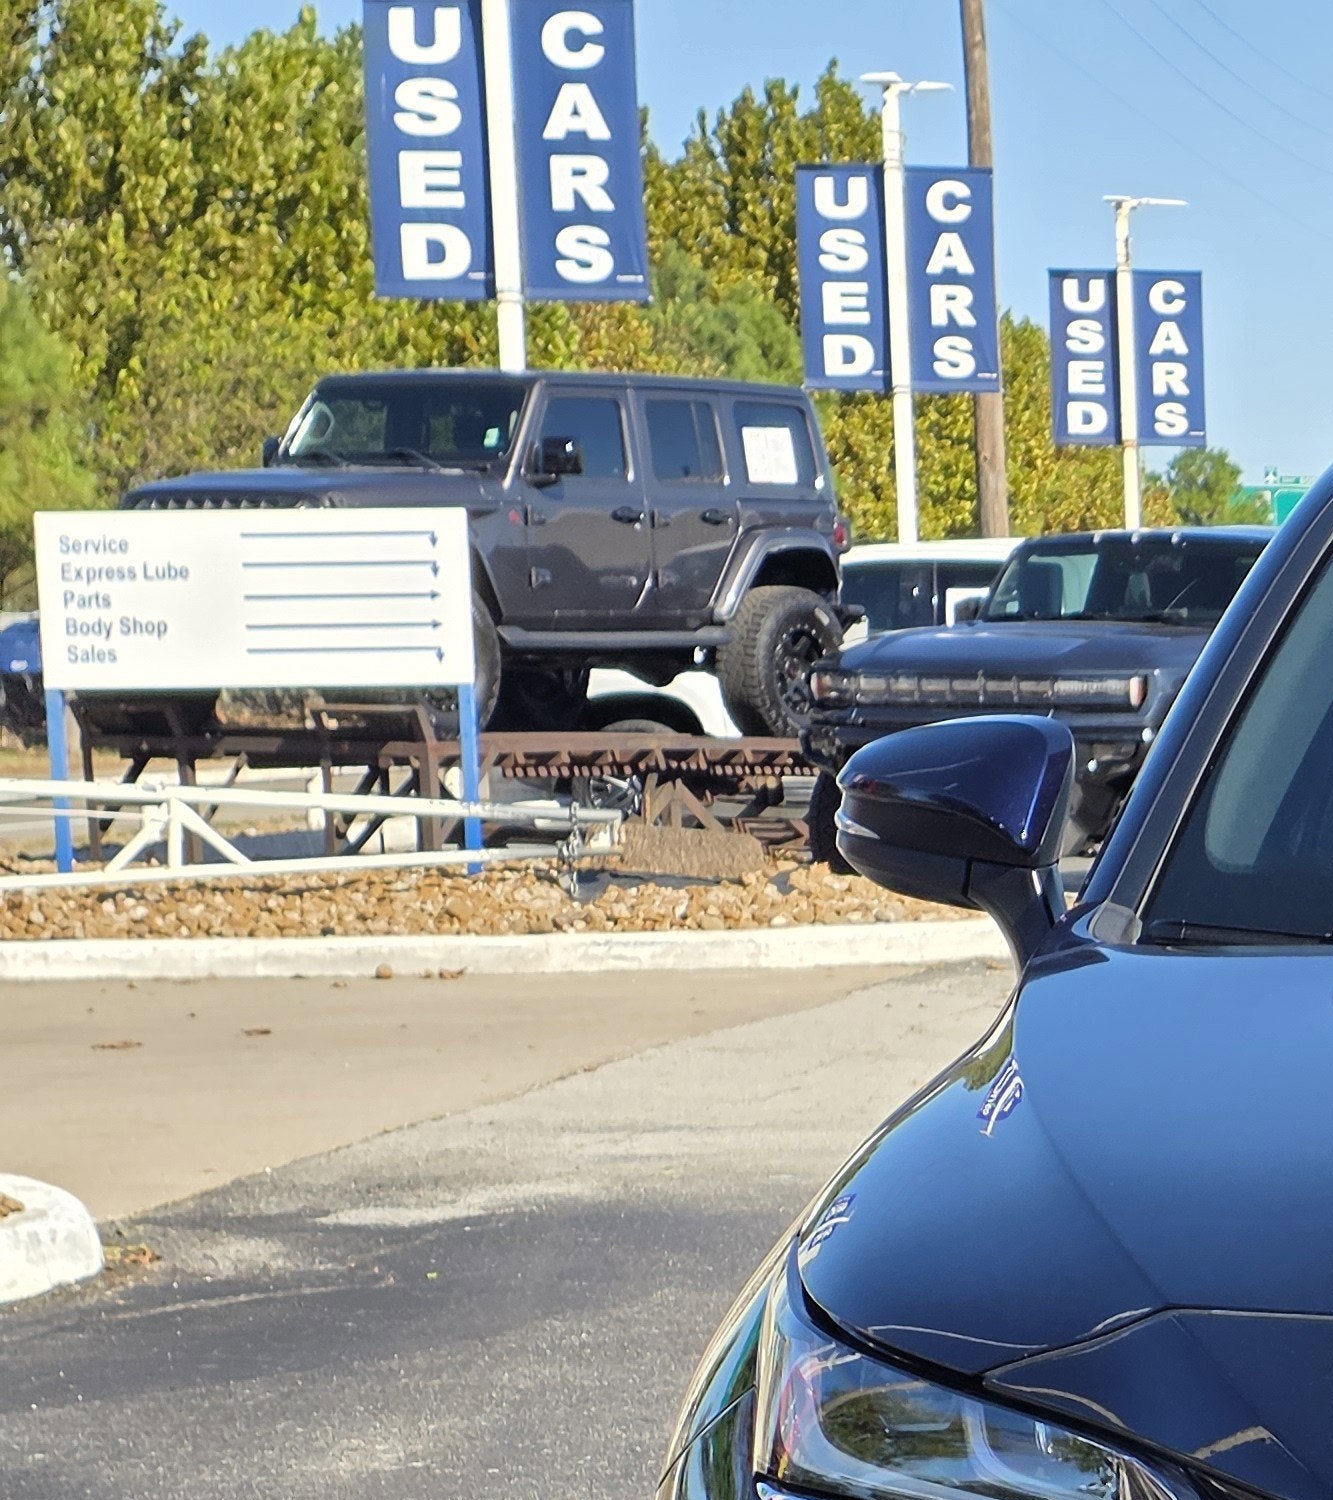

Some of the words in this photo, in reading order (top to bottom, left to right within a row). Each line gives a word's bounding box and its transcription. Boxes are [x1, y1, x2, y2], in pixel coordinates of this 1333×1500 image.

[387, 5, 472, 281] USED
[540, 10, 616, 284] CARS
[813, 176, 875, 378] USED
[925, 180, 976, 379] CARS
[1062, 278, 1108, 436] USED
[1148, 279, 1189, 437] CARS
[59, 534, 129, 555] Service
[61, 561, 137, 586] Express
[143, 560, 190, 581] Lube
[63, 589, 112, 609] Parts
[65, 616, 113, 641] Body
[119, 616, 168, 641] Shop
[67, 644, 118, 663] Sales
